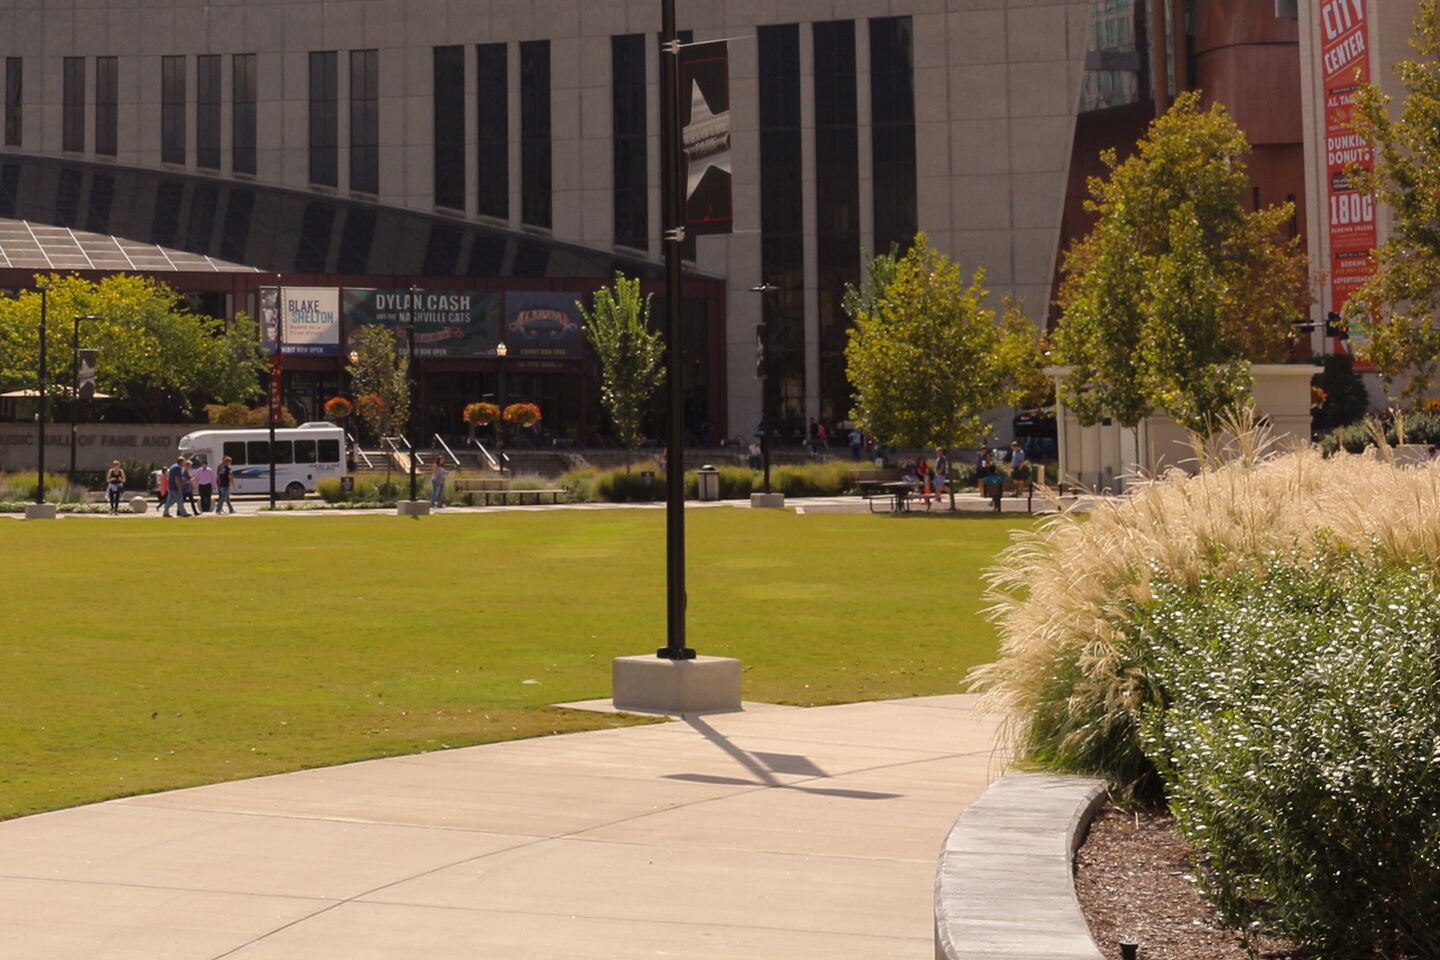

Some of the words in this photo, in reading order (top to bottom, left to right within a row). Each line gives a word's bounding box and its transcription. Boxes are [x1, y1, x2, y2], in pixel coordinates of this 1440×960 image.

[1324, 30, 1365, 74] CENTER
[288, 299, 320, 313] BLAKE
[427, 295, 470, 311] CASH
[291, 311, 334, 324] SHELTON
[399, 312, 447, 323] NASHVILLE
[448, 312, 471, 323] CATS
[101, 435, 138, 447] FAME
[142, 435, 171, 447] AND
